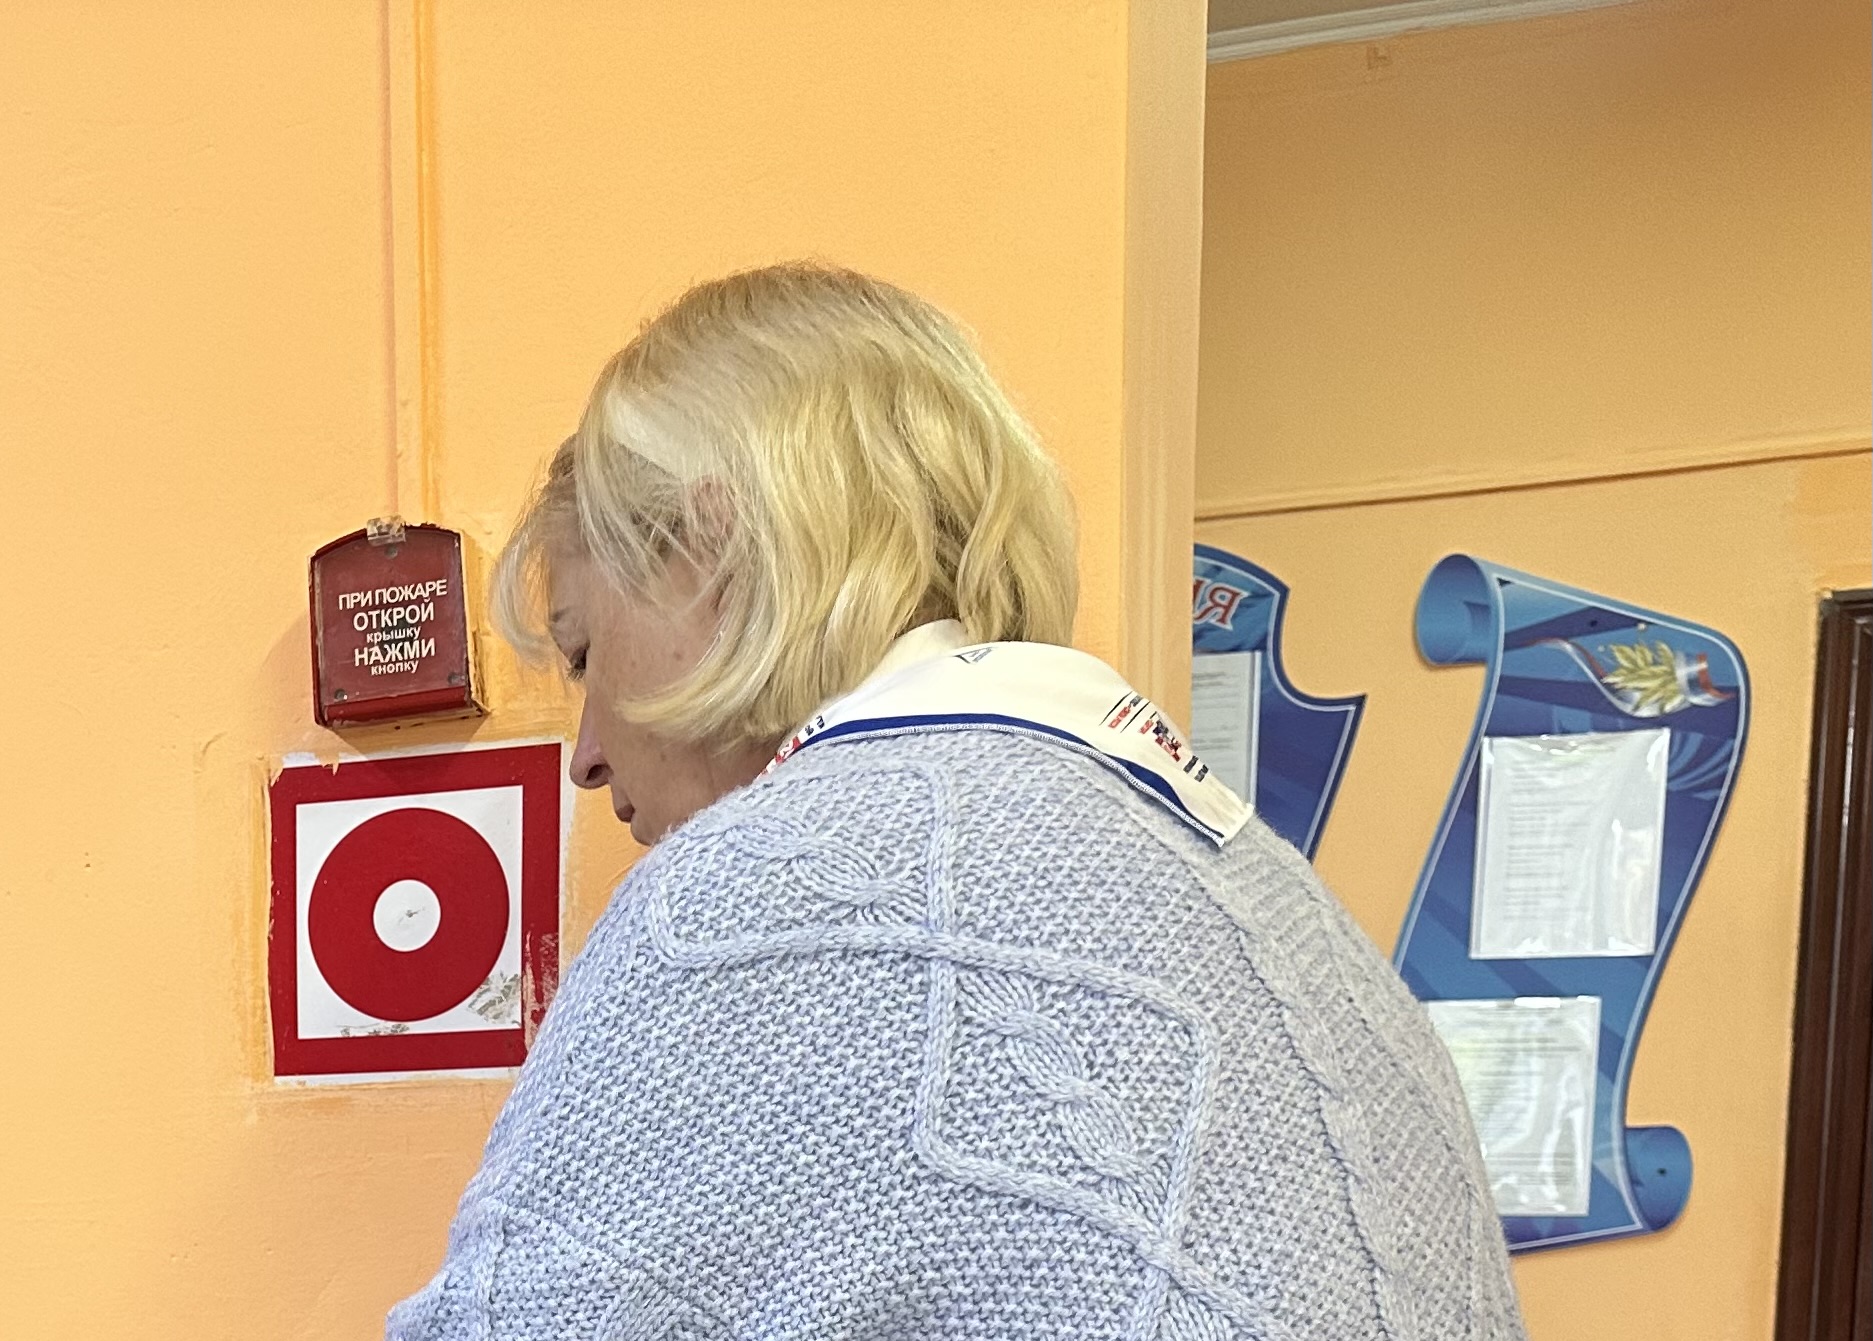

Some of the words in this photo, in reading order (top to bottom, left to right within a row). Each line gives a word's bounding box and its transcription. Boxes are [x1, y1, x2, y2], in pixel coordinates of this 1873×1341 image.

[338, 592, 372, 610] ПРИ
[375, 578, 448, 604] ПОЖАРЕ
[353, 598, 435, 631] ОТКРОЙ
[366, 625, 421, 643] крышку
[354, 638, 436, 667] НАЖМИ
[370, 660, 419, 676] кнопку
